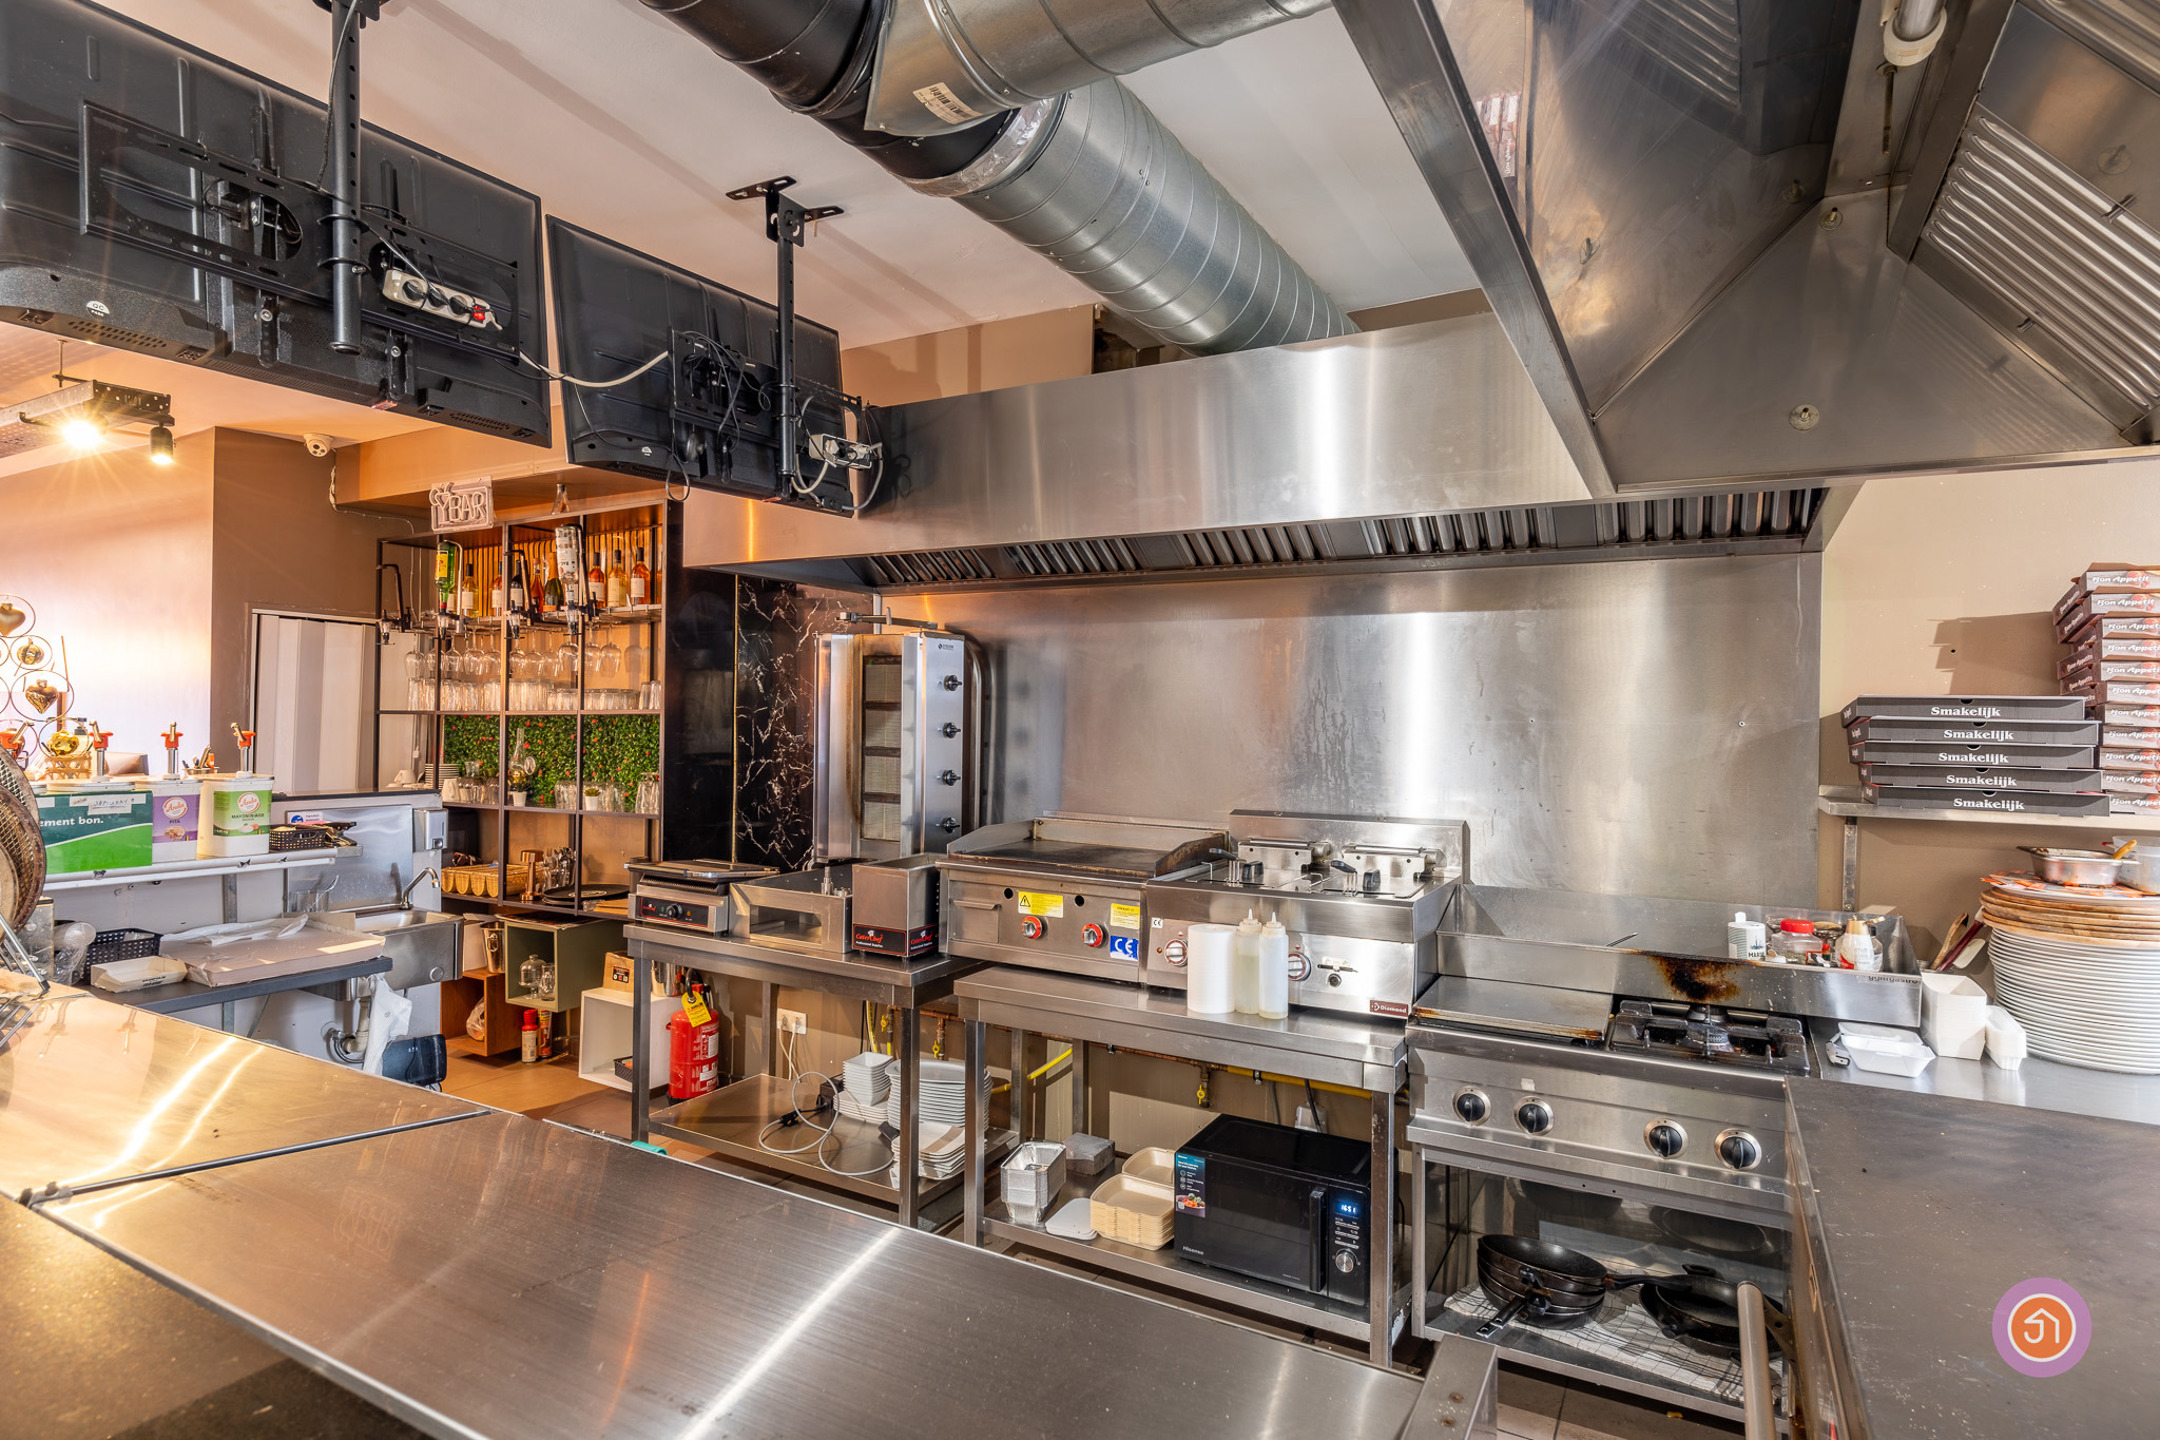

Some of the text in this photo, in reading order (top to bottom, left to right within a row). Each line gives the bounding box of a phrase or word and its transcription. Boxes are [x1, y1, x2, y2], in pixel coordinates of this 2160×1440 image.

[449, 491, 486, 521] BAR
[1930, 706, 2001, 718] Smakelijk
[1943, 730, 2014, 742] Smakelijk
[1938, 752, 2009, 765] Smakelijk
[1946, 775, 2017, 788] Smakelijk
[1953, 798, 2025, 811] Smakelijk
[78, 816, 104, 825] bon.
[1115, 939, 1133, 954] CE
[1380, 1005, 1407, 1013] Diamond
